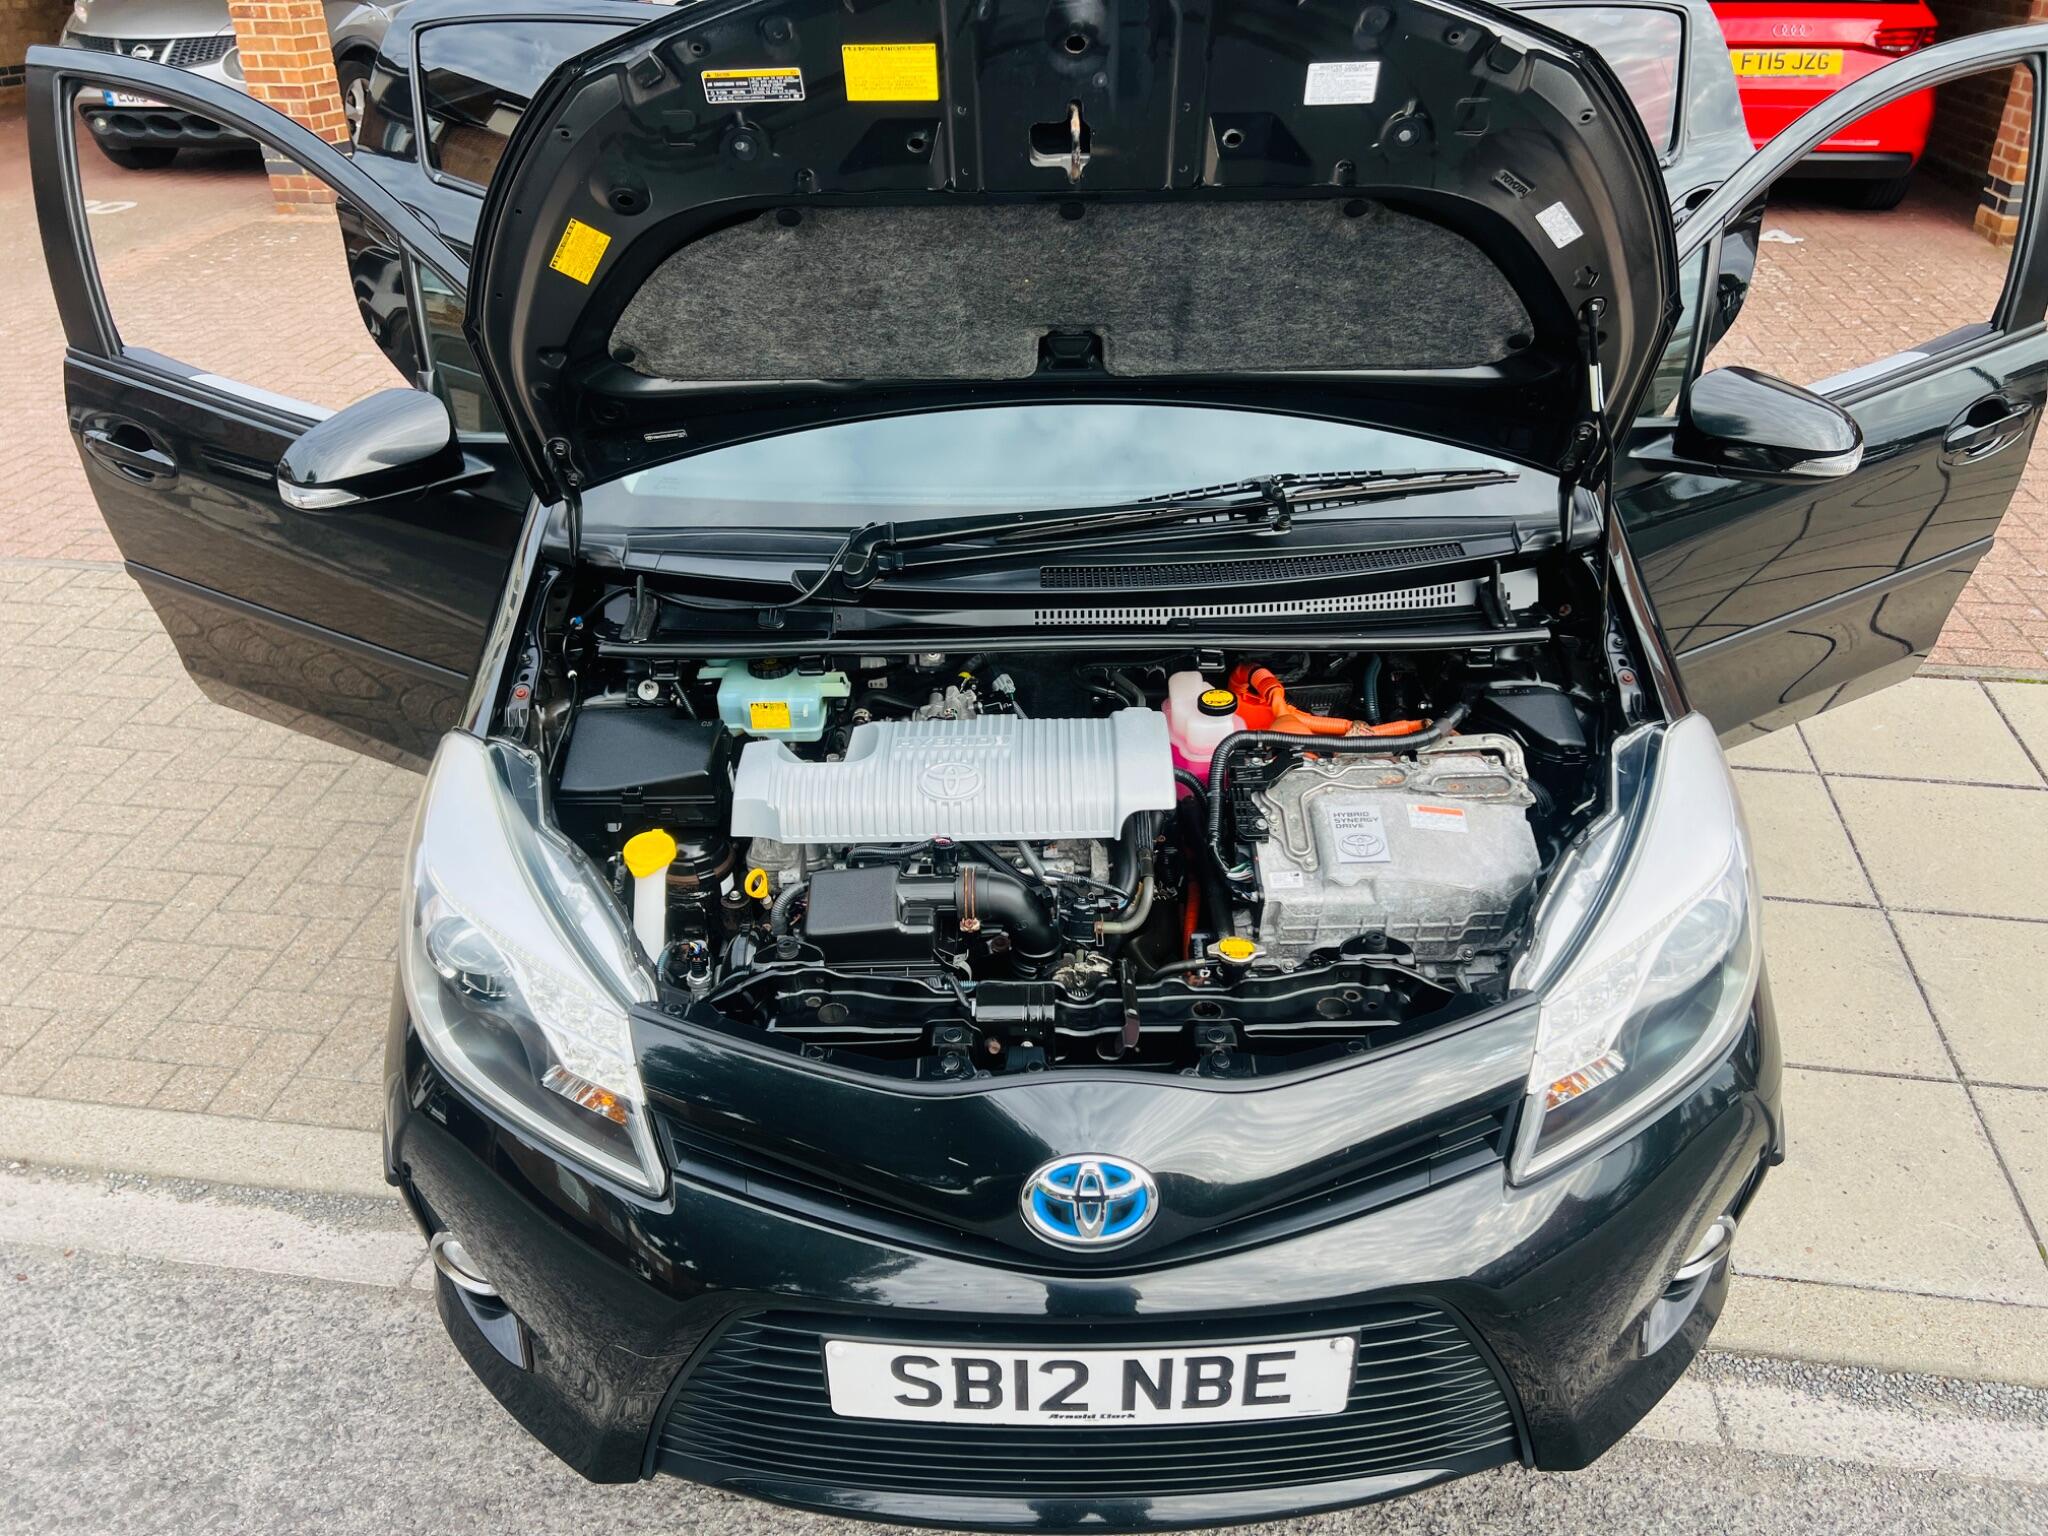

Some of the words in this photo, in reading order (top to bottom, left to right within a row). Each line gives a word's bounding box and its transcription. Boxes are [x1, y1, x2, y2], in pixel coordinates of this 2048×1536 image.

[1741, 52, 1786, 70] FT15
[1792, 52, 1830, 70] JZG
[1501, 173, 1528, 194] TOYOTA
[890, 1354, 1089, 1411] SB12
[1121, 1350, 1297, 1411] NBE
